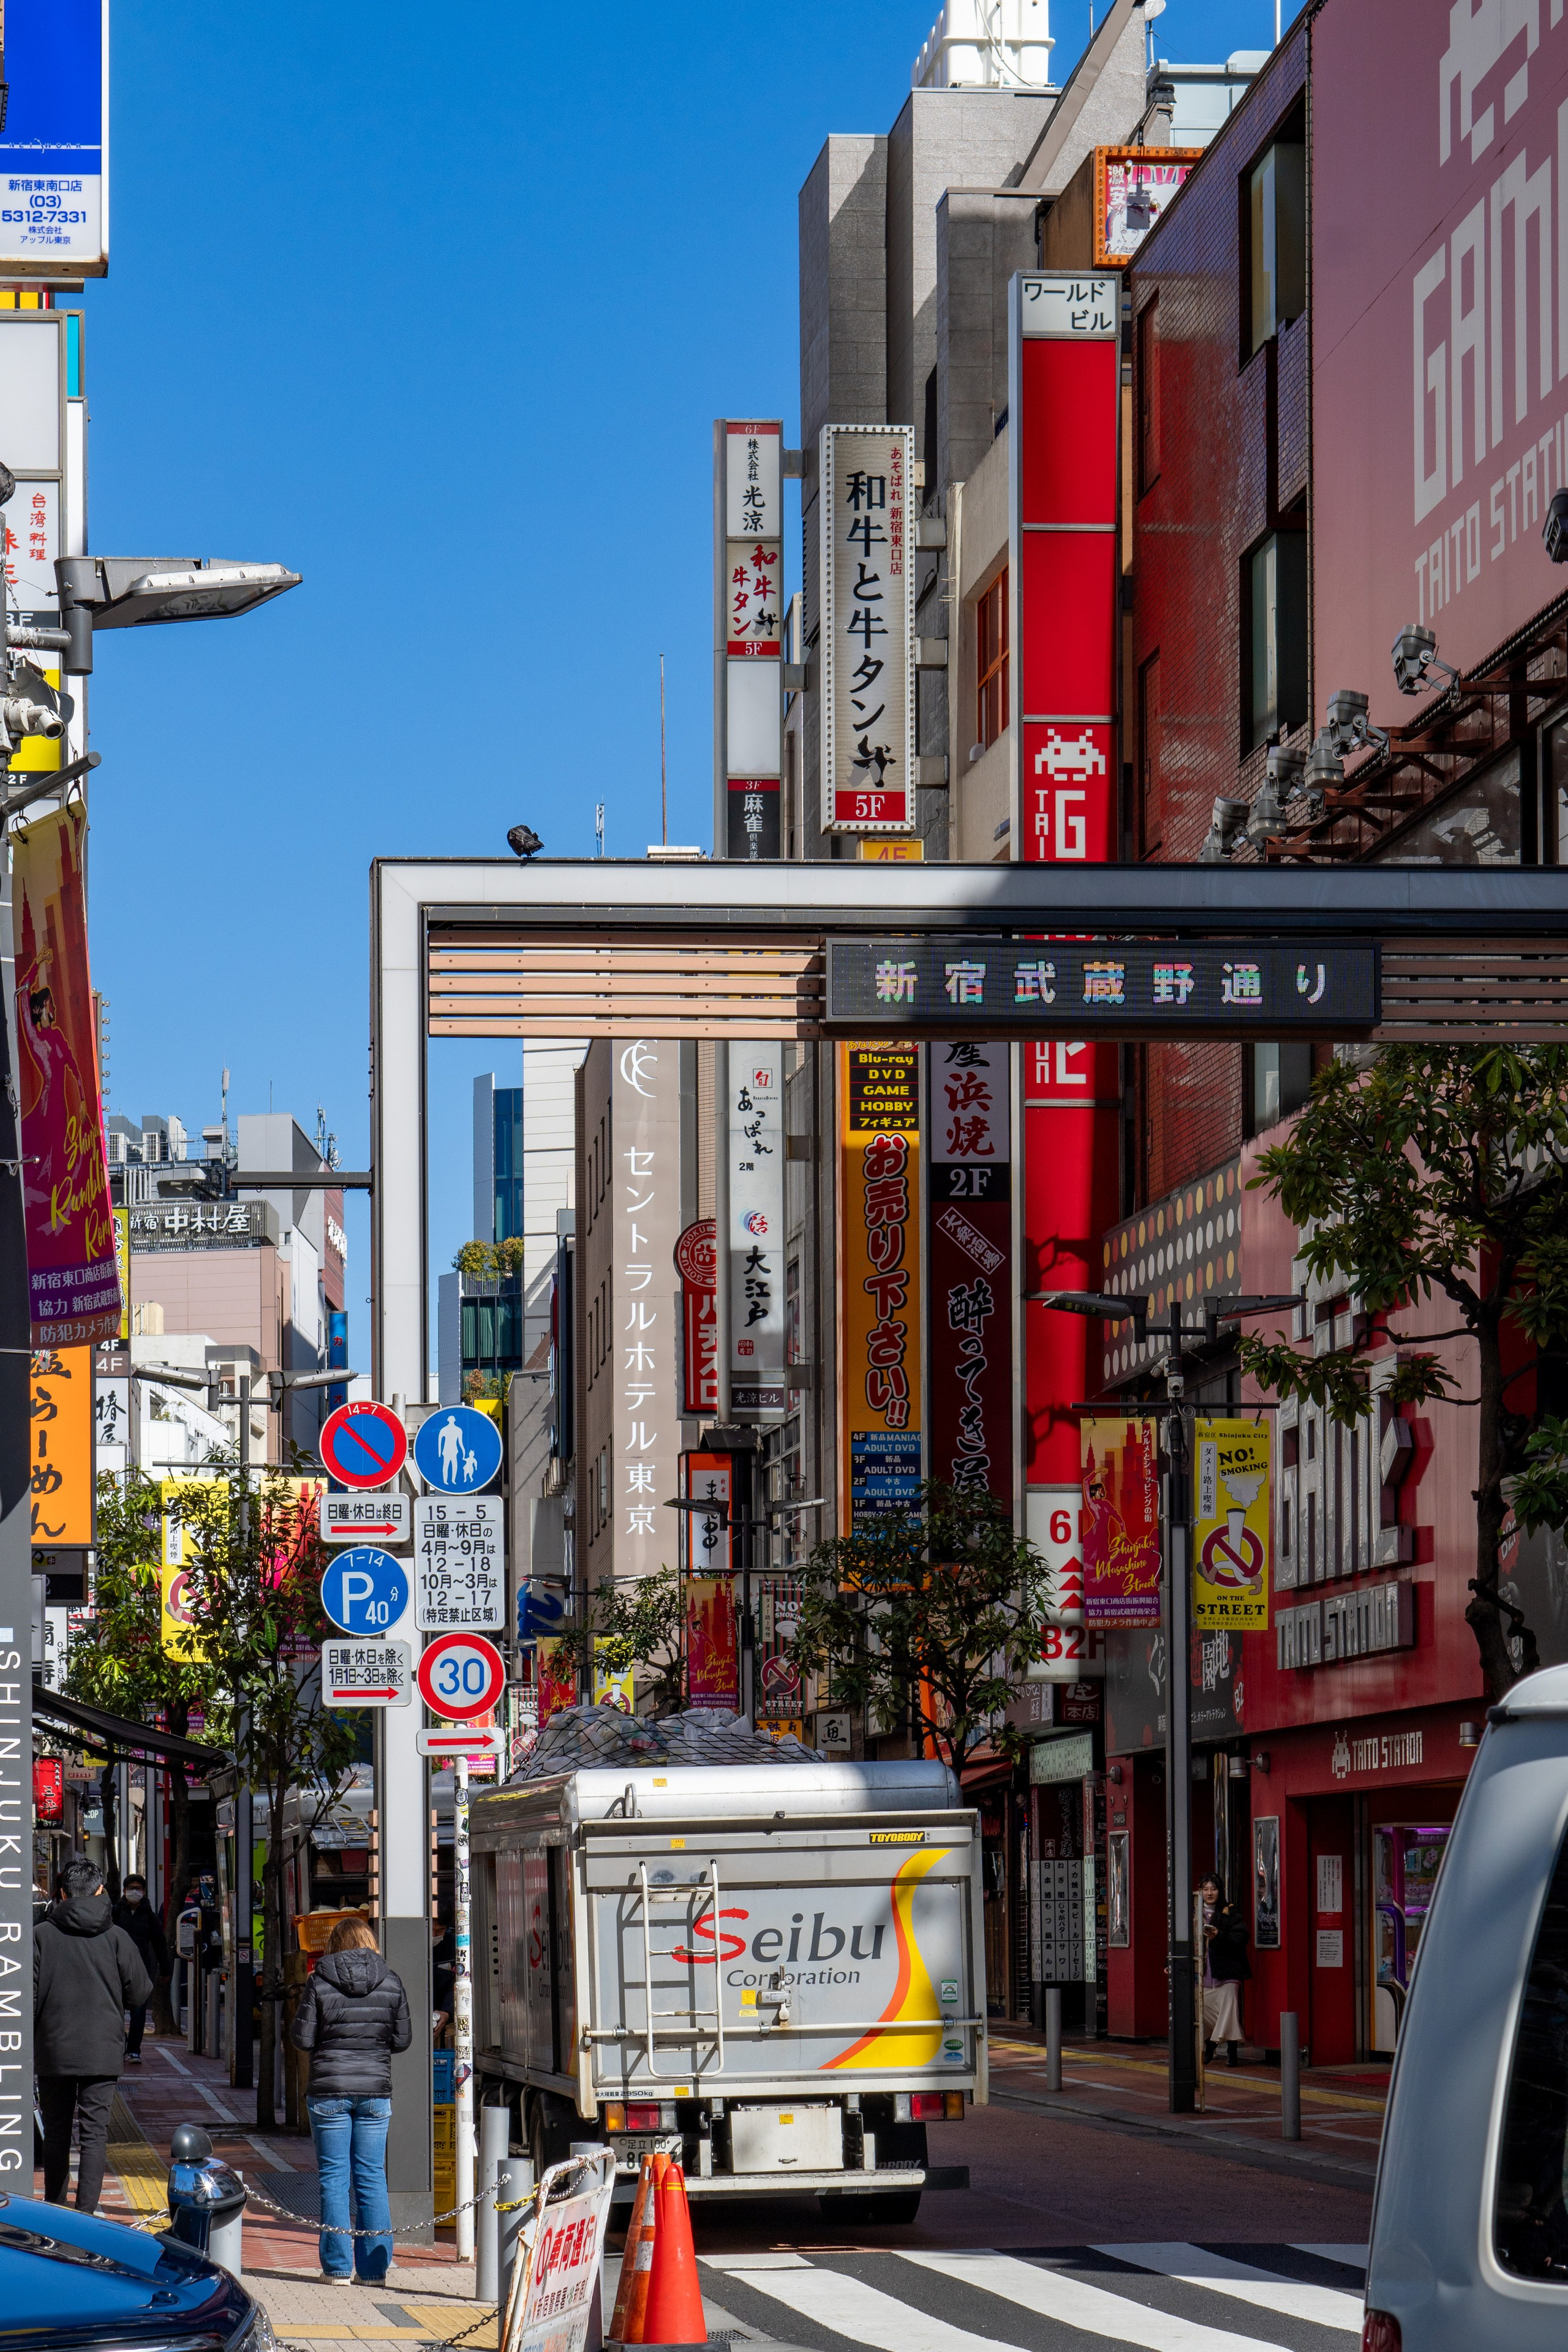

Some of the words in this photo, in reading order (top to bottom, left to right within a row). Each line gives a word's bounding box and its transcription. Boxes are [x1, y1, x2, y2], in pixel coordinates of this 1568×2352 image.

[8, 179, 83, 192] 新宿東南口店
[29, 195, 62, 209] (03)
[2, 211, 87, 223] 5312-7331
[28, 225, 62, 235] 株式会社
[20, 235, 71, 245] アップル東京
[1025, 282, 1106, 303] ワールド
[1072, 309, 1112, 331] ビル
[745, 424, 762, 434] 6F
[747, 439, 759, 481] 株式会社
[890, 447, 902, 501] あそばれ
[742, 484, 766, 532] 光涼
[29, 492, 47, 560] 台湾料理
[889, 506, 903, 576] 新宿東口店
[1415, 499, 1480, 627] TAITO
[750, 544, 778, 602] 和牛
[732, 565, 752, 636] 牛タン
[846, 470, 889, 732] 和牛と牛タン
[745, 641, 763, 655] 5F
[745, 780, 762, 790] 3F
[855, 795, 886, 818] 5F
[875, 960, 1327, 1005] 新宿武蔵野通り
[859, 1054, 913, 1066] Blu-ray
[869, 1069, 905, 1079] DVD
[863, 1085, 909, 1095] GAME
[861, 1101, 914, 1111] HOBBY
[738, 1086, 773, 1155] あっぱれ
[859, 1117, 916, 1128] フィギュア
[739, 1162, 755, 1171] 2階
[949, 1167, 992, 1196] 2F
[683, 1226, 705, 1248] GOKU
[744, 1245, 772, 1327] 大江戸
[38, 1298, 67, 1317] 協力
[100, 1340, 119, 1351] 4F
[624, 1146, 657, 1535] セントラルホテル東京
[96, 1358, 123, 1372] 4F
[736, 1391, 780, 1404] 光涼ビル
[347, 1404, 379, 1415] 14-7
[853, 1433, 865, 1441] 4F
[1218, 1447, 1255, 1466] NO!
[1220, 1461, 1268, 1477] SMOKING
[328, 1503, 402, 1520] 日曜・休日は終日
[424, 1523, 492, 1539] 日曜・休日の
[1108, 1534, 1156, 1561] Shinjuku
[344, 1551, 385, 1567] 7-14
[1095, 1557, 1148, 1580] Musashino
[390, 1586, 399, 1602] 分
[1122, 1573, 1155, 1597] Street
[342, 1571, 374, 1624] P
[365, 1600, 389, 1625] 40
[423, 1607, 498, 1624] (特定禁止区域)
[1088, 1608, 1102, 1617] 協力
[1196, 1604, 1265, 1616] STREET
[1089, 1618, 1148, 1627] 防犯カメラ作動中
[330, 1648, 403, 1665] 日曜・休日を除く
[439, 1657, 484, 1695] 30
[1352, 1738, 1379, 1771] TAITO
[1381, 1731, 1423, 1768] STATION
[0, 1651, 21, 1888] SHINJUKU
[870, 1833, 924, 1842] TOYOBODY
[672, 1908, 886, 1964] Seibu
[726, 1967, 861, 1988] Corporation
[0, 1922, 22, 2171] RAMBLING
[628, 2139, 647, 2149] 足立
[650, 2139, 666, 2149] 100
